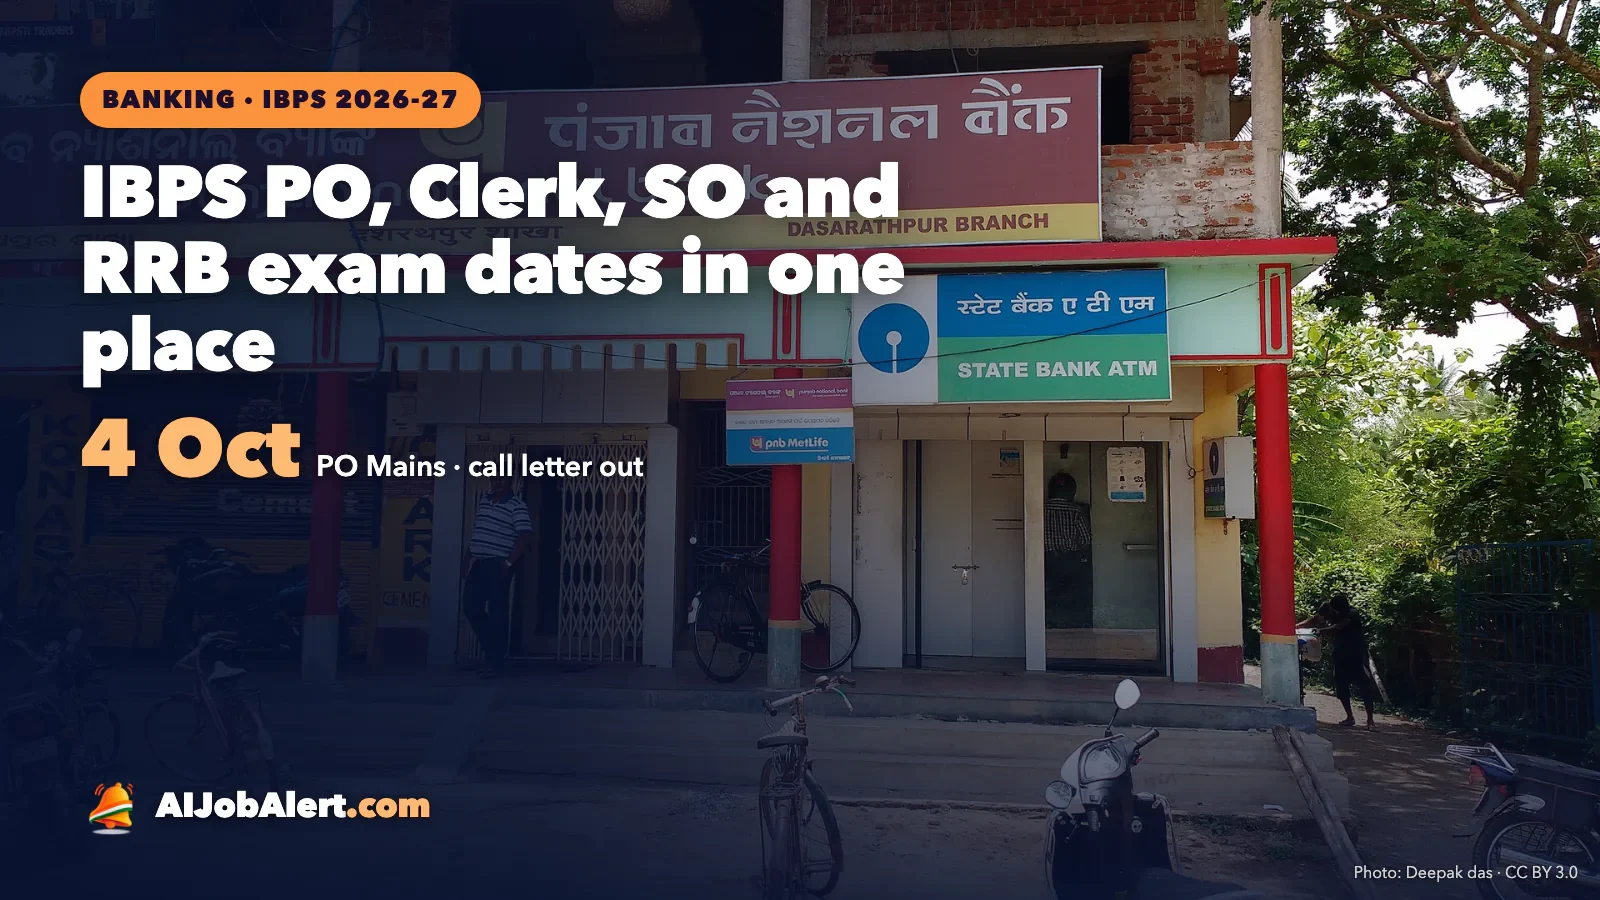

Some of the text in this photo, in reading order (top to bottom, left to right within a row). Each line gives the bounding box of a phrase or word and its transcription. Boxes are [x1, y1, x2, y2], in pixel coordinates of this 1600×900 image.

[544, 77, 1071, 152] पंजाब नैशनल बैंक
[786, 212, 1050, 238] DASARATHPUR BRANCH
[957, 290, 1155, 316] स्टेट बैंक ए टी एम
[958, 360, 1157, 378] STATE BANK ATM
[765, 437, 829, 450] pnb MetLife
